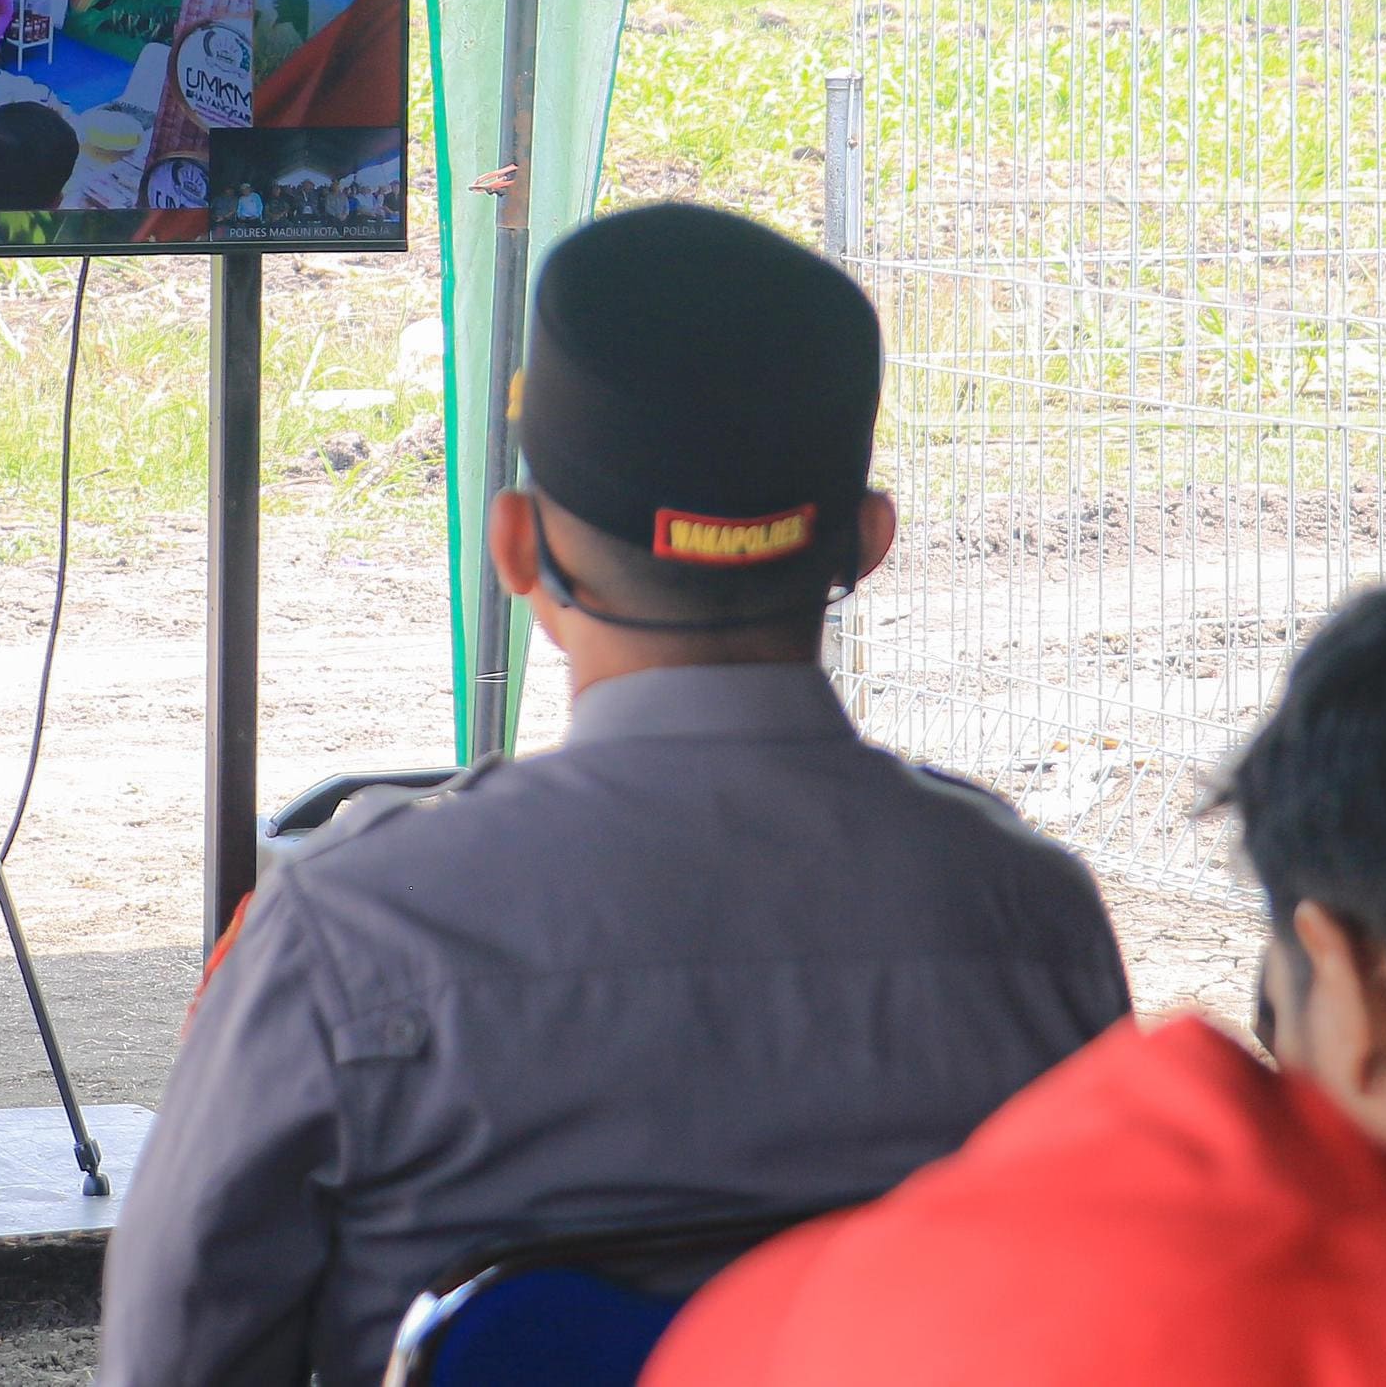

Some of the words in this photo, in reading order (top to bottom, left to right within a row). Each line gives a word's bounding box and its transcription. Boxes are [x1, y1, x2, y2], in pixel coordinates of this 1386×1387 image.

[186, 67, 253, 111] UMKM
[229, 227, 266, 238] POLRES
[269, 227, 311, 238] MADIUN
